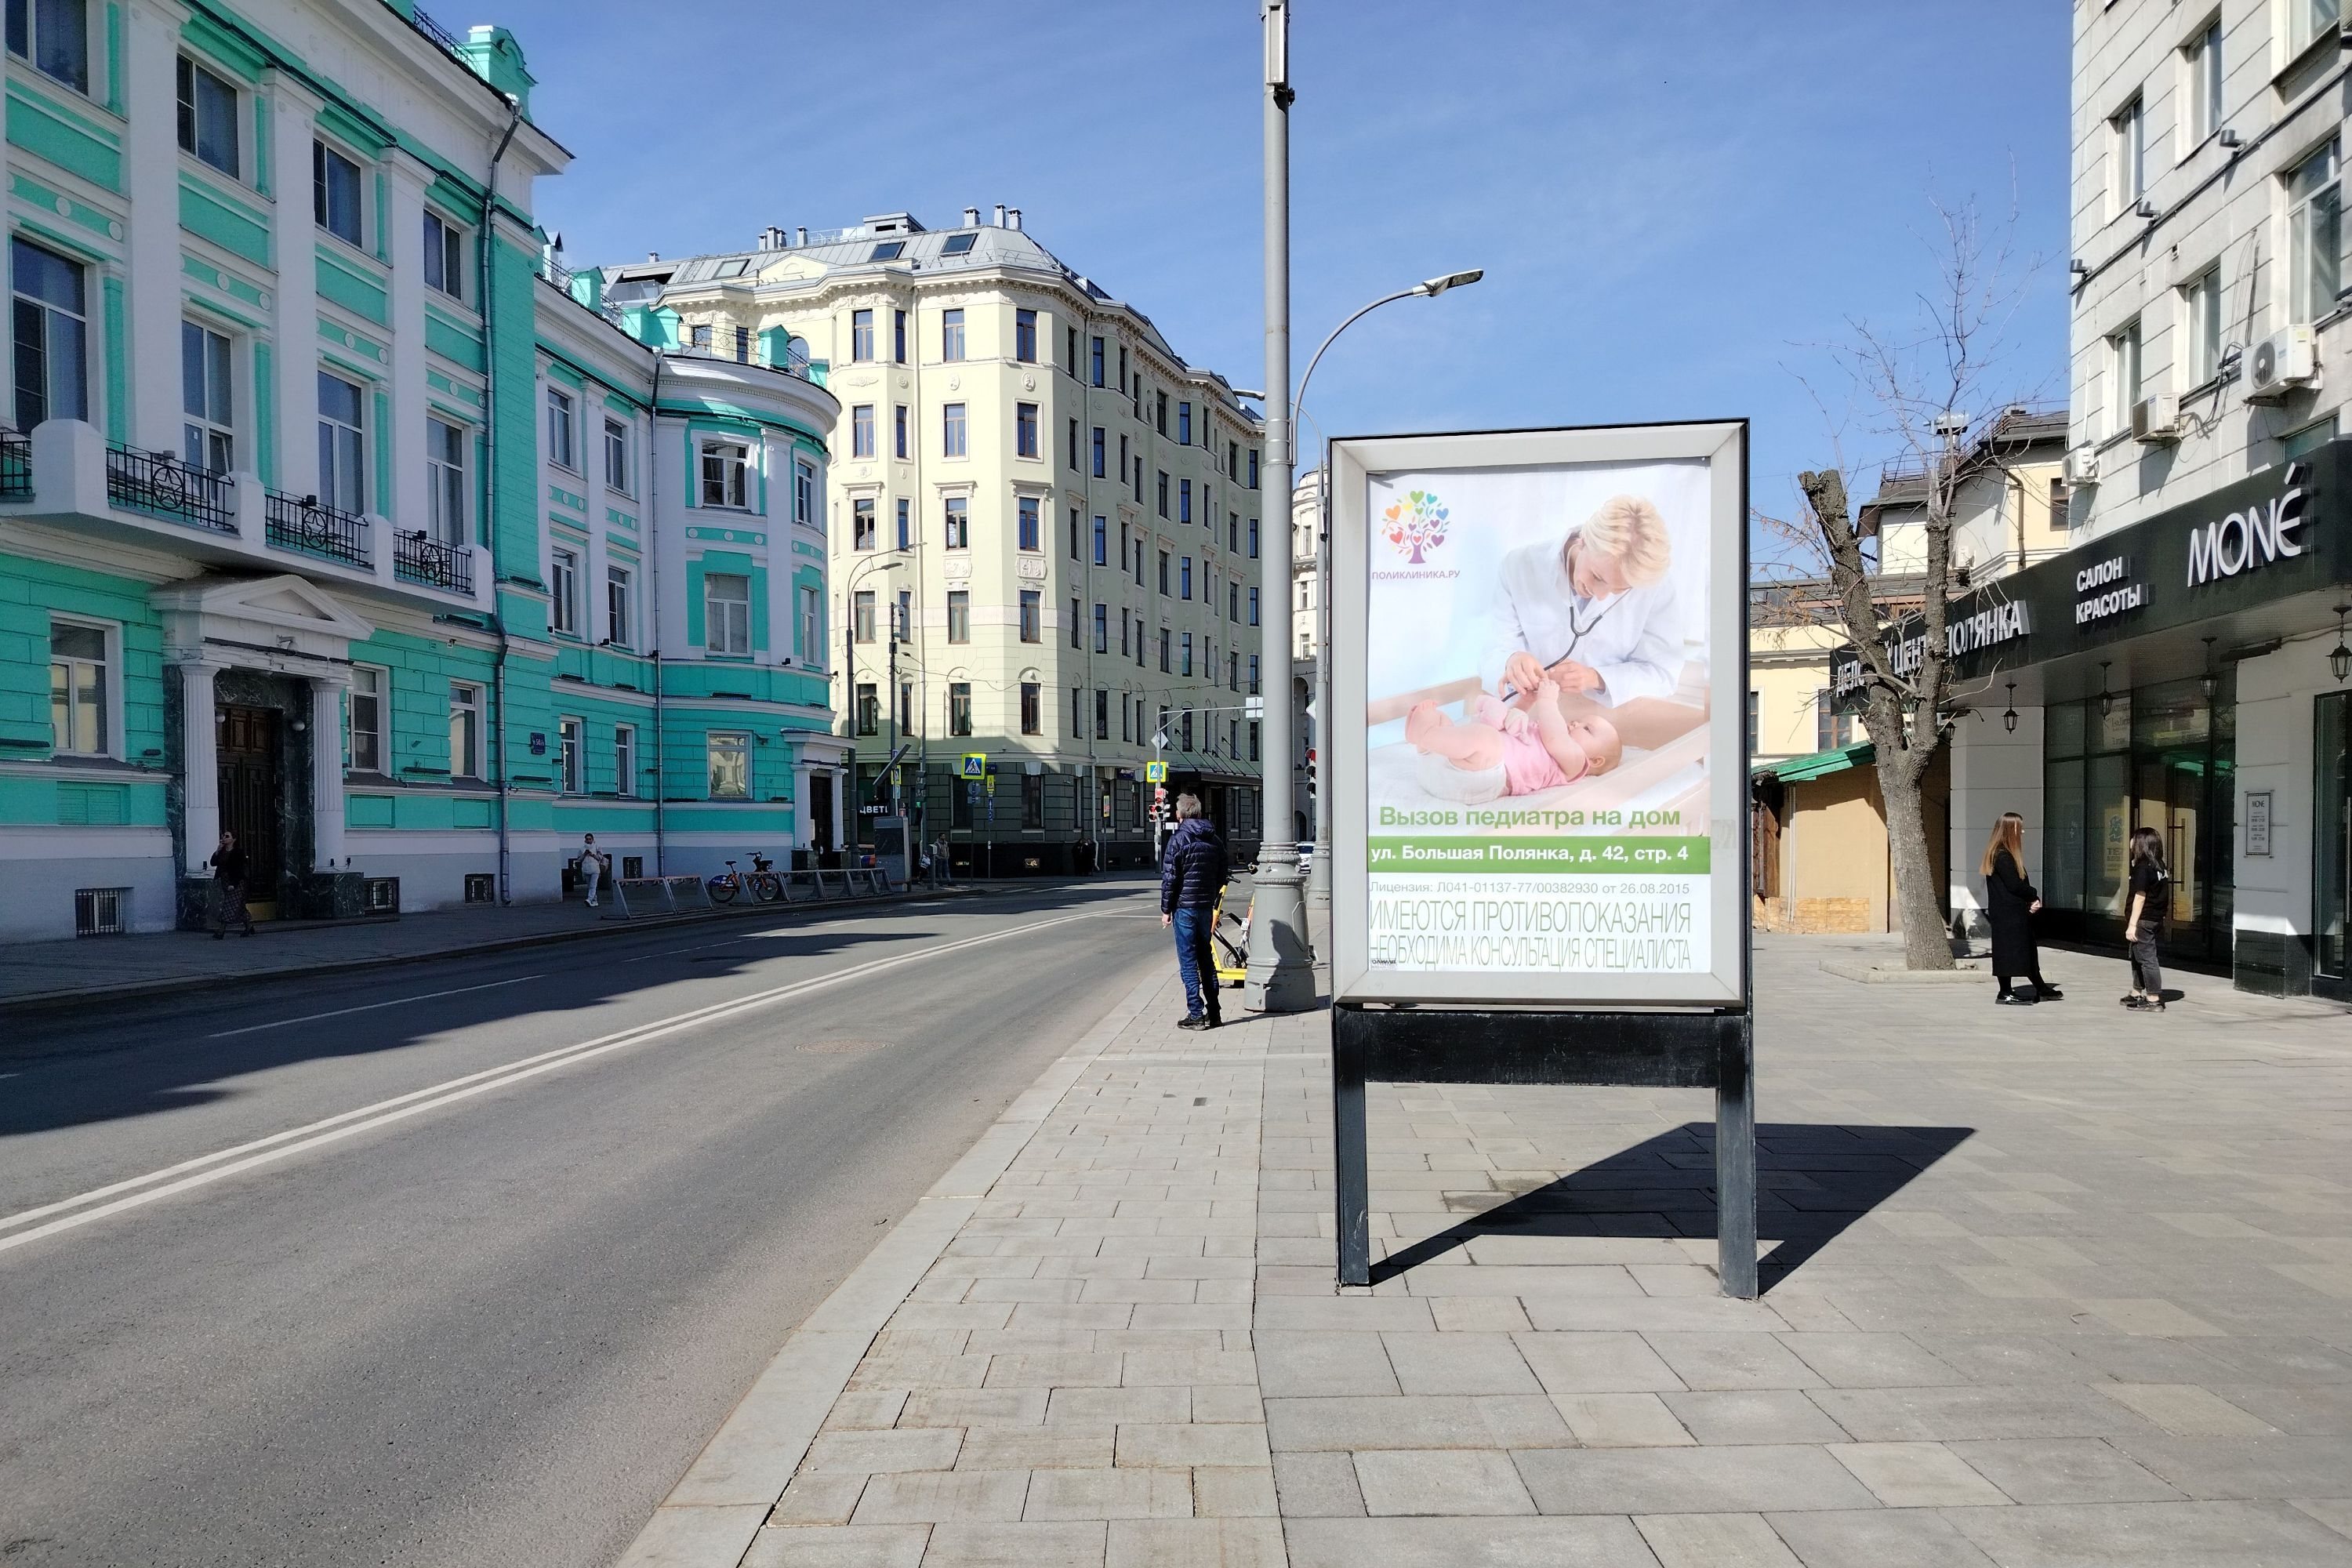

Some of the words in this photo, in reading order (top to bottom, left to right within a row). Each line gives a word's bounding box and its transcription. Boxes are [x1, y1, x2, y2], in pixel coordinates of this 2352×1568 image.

[2187, 462, 2302, 587] MONÉ
[1372, 570, 1461, 579] ПОЛИКЛИНИКА.РУ
[2076, 556, 2123, 592] САЛОН
[2075, 584, 2141, 625] КРАСОТЫ
[1379, 806, 1458, 826] Вызов
[1466, 810, 1584, 829] педиатра
[1592, 810, 1622, 826] на
[1628, 810, 1681, 829] дом
[1370, 848, 1396, 862] ул.
[1402, 845, 1483, 860] Большая
[1490, 845, 1574, 862] Полянка,
[1579, 848, 1597, 862] д.
[1602, 845, 1629, 863] 42,
[1634, 848, 1671, 864] стр.
[1677, 845, 1689, 860] 4
[1370, 881, 1433, 894] Лицензия:
[1437, 882, 1599, 894] Л041-01137-77/00382930
[1602, 885, 1617, 894] от
[1620, 883, 1690, 895] 26.08.2015
[1370, 900, 1466, 931] ИМЕЮТСЯ
[1473, 900, 1691, 934] ПРОТИВОПОКАЗАНИЯ
[1370, 935, 1468, 971] НЕОБХОДИМА
[1471, 935, 1581, 972] КОНСУЛЬТАЦИЯ
[1584, 938, 1692, 973] СПЕЦИАЛИСТА
